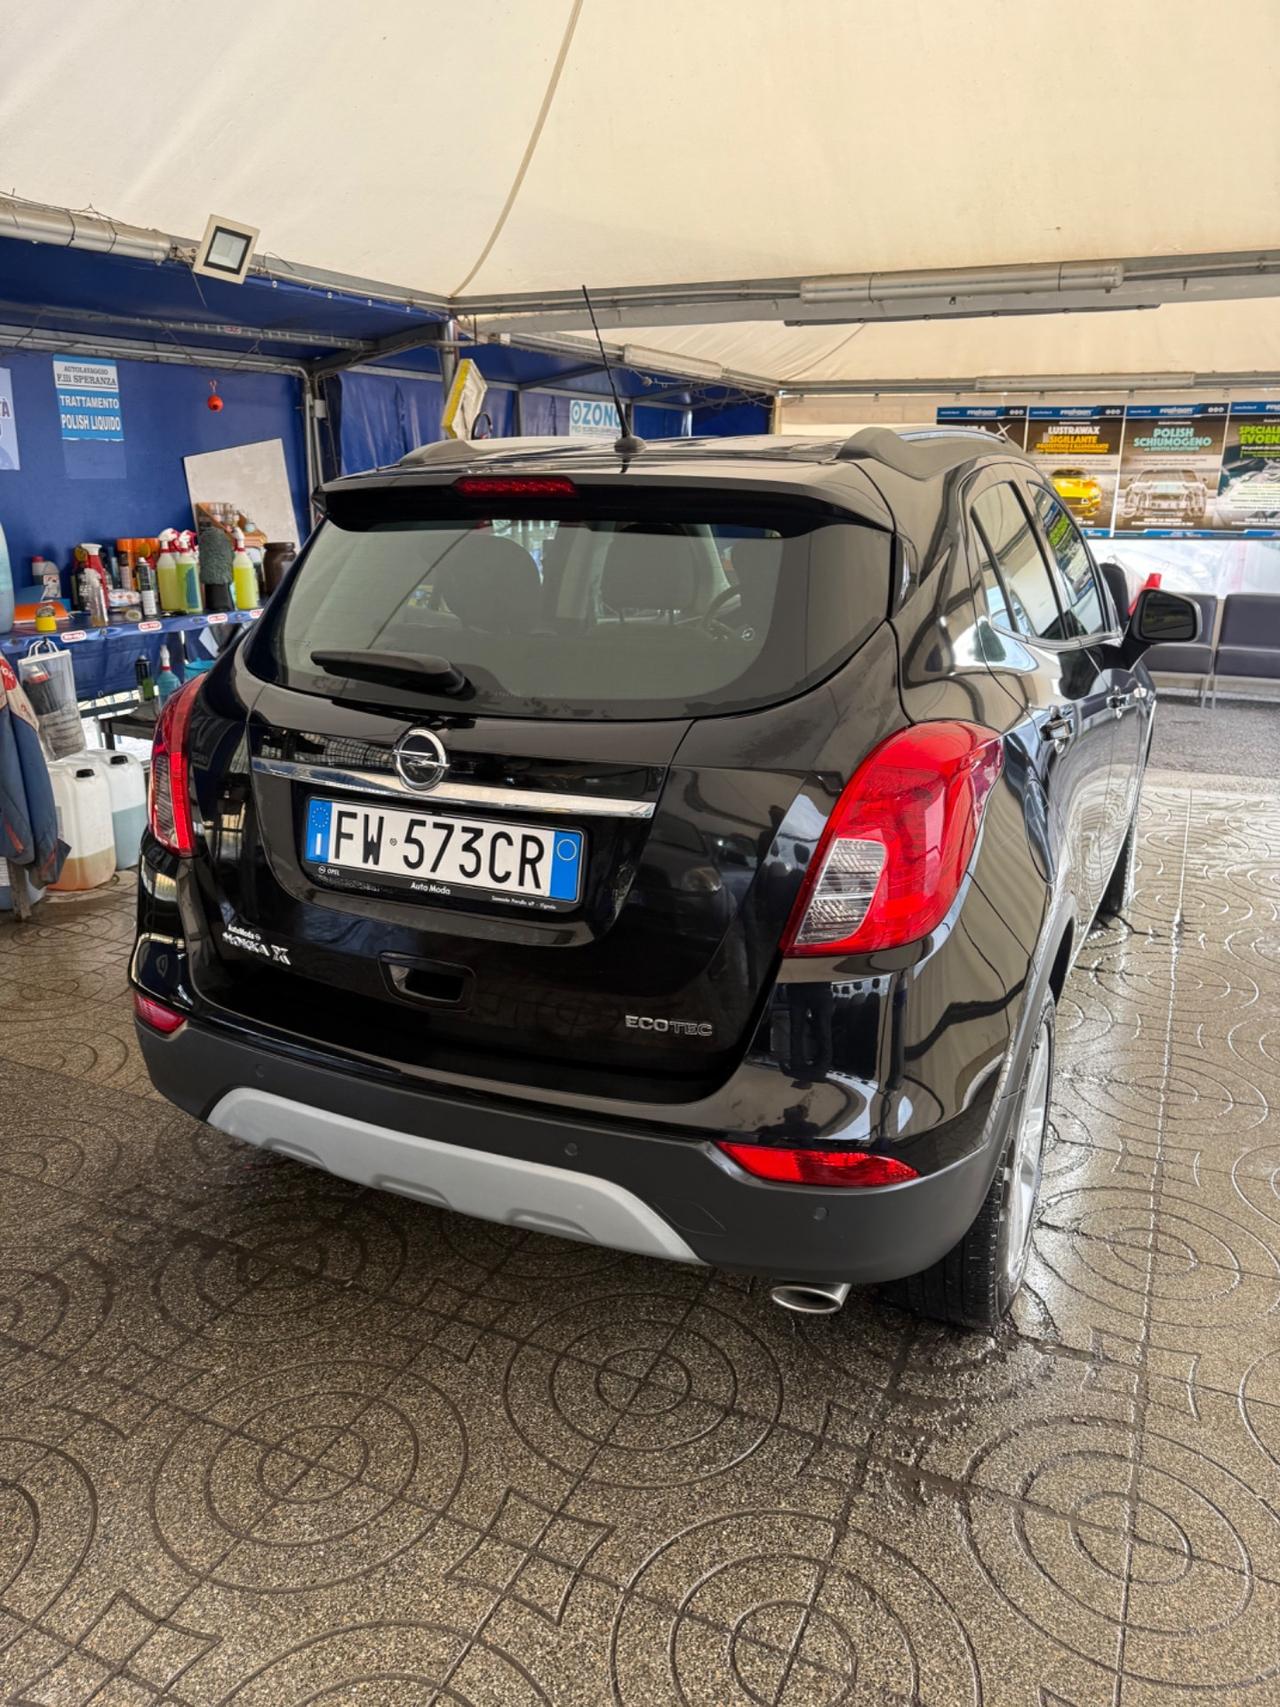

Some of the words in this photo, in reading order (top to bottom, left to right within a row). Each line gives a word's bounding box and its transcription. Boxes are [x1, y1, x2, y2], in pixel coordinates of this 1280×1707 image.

[64, 366, 109, 376] AUTOLAVAGGIO
[73, 375, 116, 385] SPERANZA
[60, 395, 120, 409] TRATTAMENTO
[61, 414, 89, 429] POLISH
[90, 416, 121, 431] LIQUIDO
[1048, 426, 1100, 435] LUSTRAWAX
[1153, 427, 1194, 437] POLISH
[1049, 435, 1098, 444] SIGILLANTE
[1133, 436, 1212, 447] SCHIUMOGENO
[334, 810, 385, 866] FW
[402, 818, 545, 890] 573CR
[327, 868, 340, 876] OPEL
[410, 882, 429, 892] Auto
[429, 884, 451, 896] Moda
[625, 1014, 713, 1036] ECOTEC
